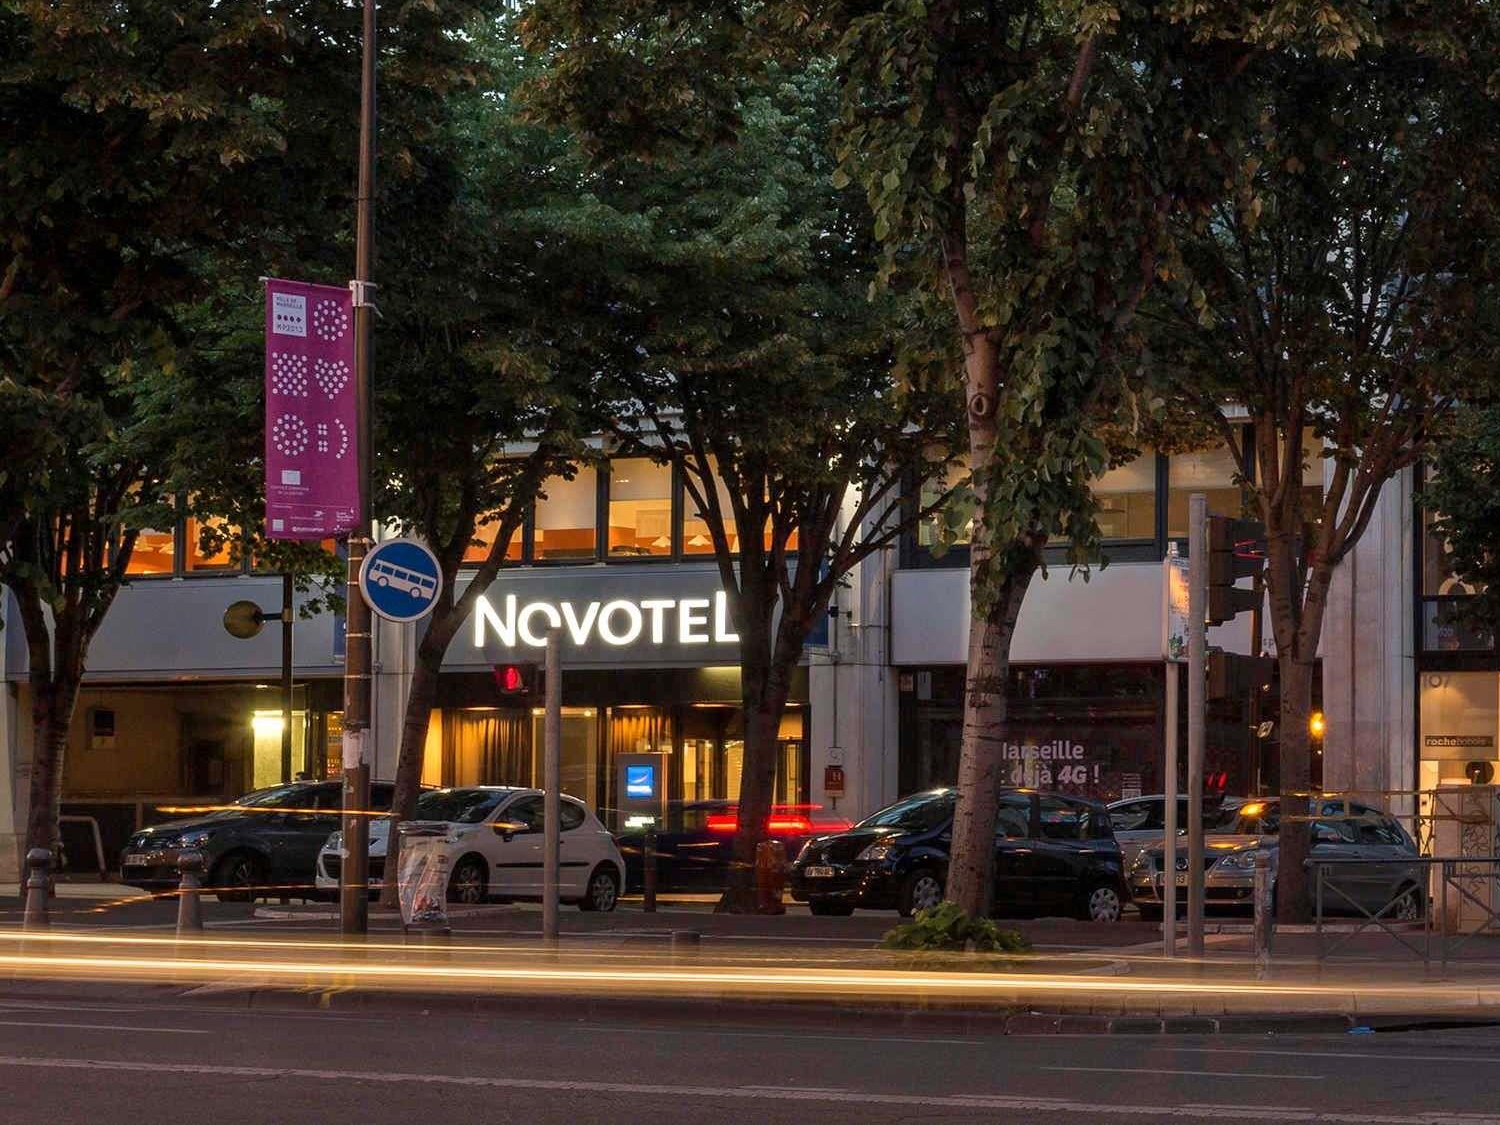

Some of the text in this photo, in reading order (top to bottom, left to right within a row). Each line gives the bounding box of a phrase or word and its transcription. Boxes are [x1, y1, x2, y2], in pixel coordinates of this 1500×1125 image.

[474, 591, 740, 647] NOVOTEL
[1010, 763, 1053, 787] déjà
[1057, 764, 1087, 784] 4G
[1094, 764, 1100, 784] !
